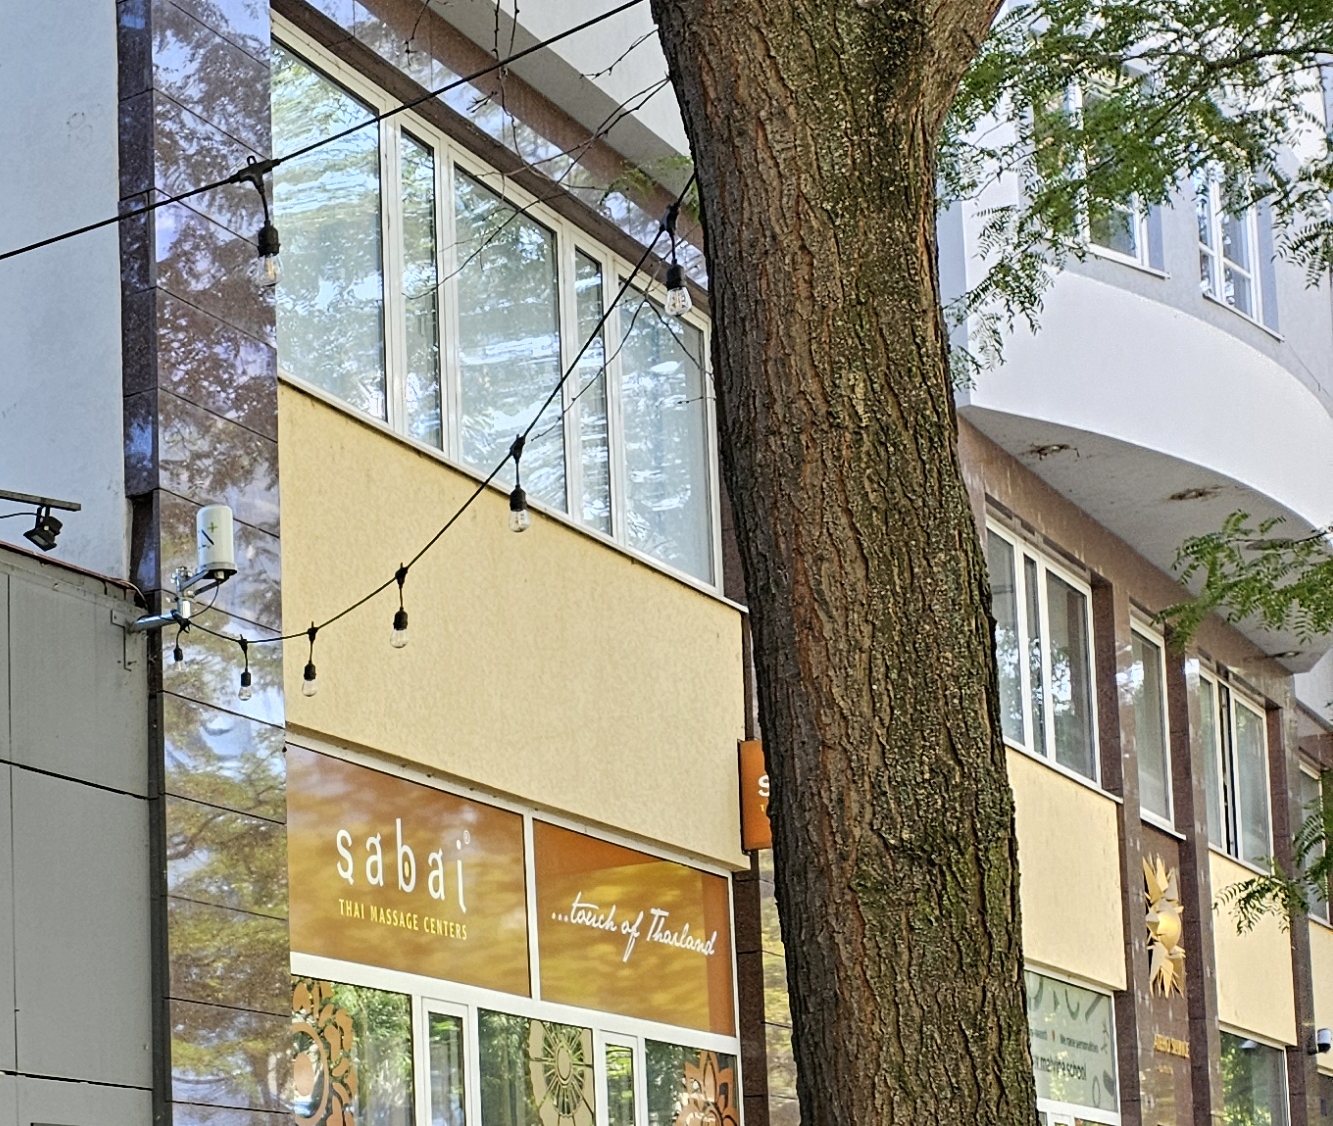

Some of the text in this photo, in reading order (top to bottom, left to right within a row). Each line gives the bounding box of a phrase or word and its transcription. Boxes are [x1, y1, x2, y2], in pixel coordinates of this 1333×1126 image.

[338, 898, 468, 941] THAI MASSAGE CENTERS
[620, 910, 644, 963] of
[646, 907, 718, 956] Thailand
